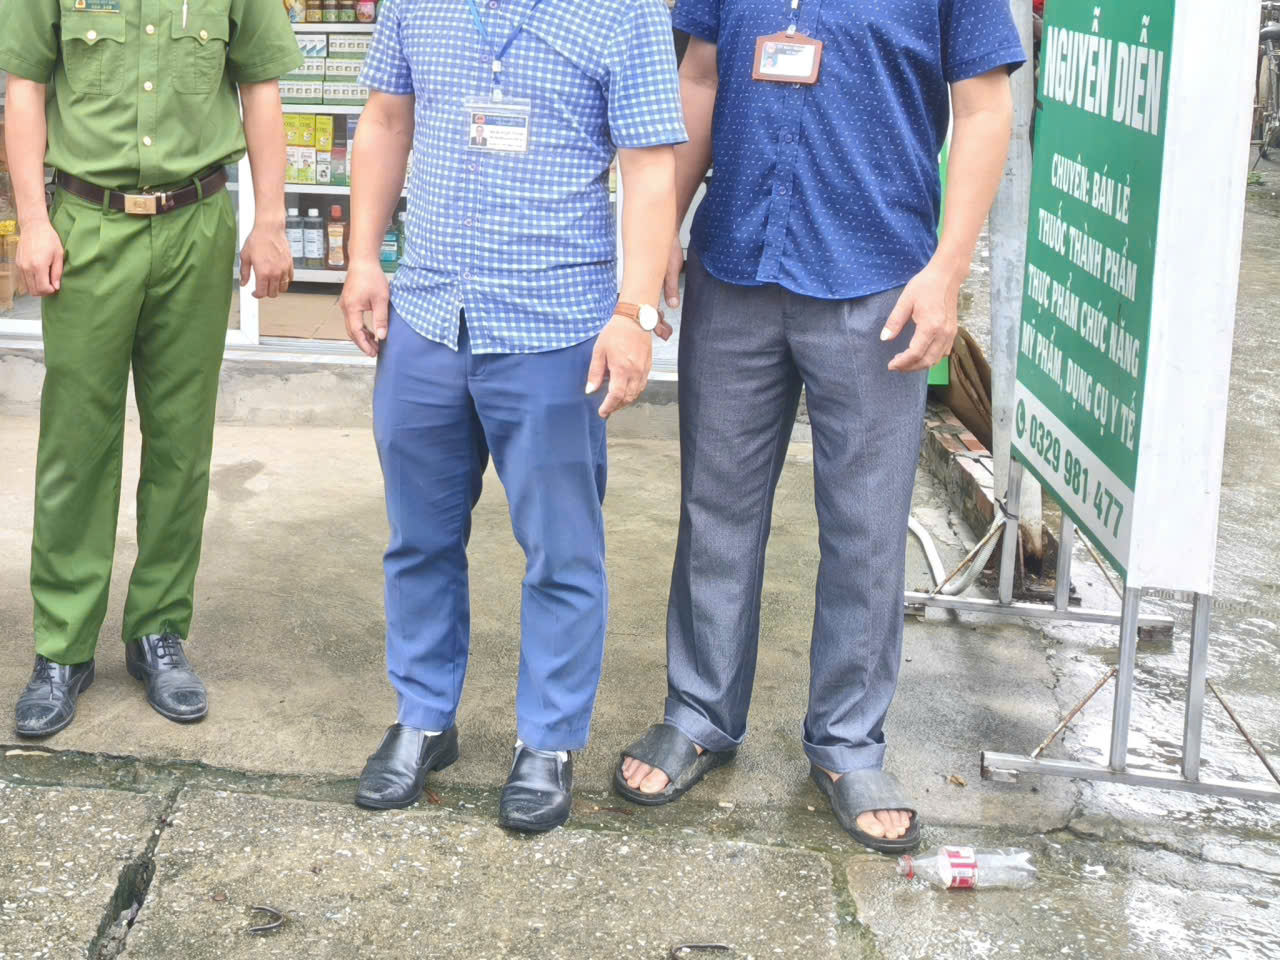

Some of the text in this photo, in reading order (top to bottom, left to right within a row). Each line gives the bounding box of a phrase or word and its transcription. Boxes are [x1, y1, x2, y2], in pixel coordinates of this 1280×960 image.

[1043, 6, 1164, 136] NGUYỄN DIỄN
[1051, 152, 1131, 224] CHUYÊN: BÁN LẺ
[1038, 200, 1138, 302] THUỐC THÀNH PHẨM
[1028, 262, 1140, 378] THỰC PHẨM CHỨC NĂNG
[1066, 358, 1093, 412] DỤNG
[1094, 382, 1109, 436] CỤ
[1111, 395, 1119, 434] Y
[1120, 391, 1136, 452] TẾ
[1030, 414, 1124, 538] 0329 981 477
